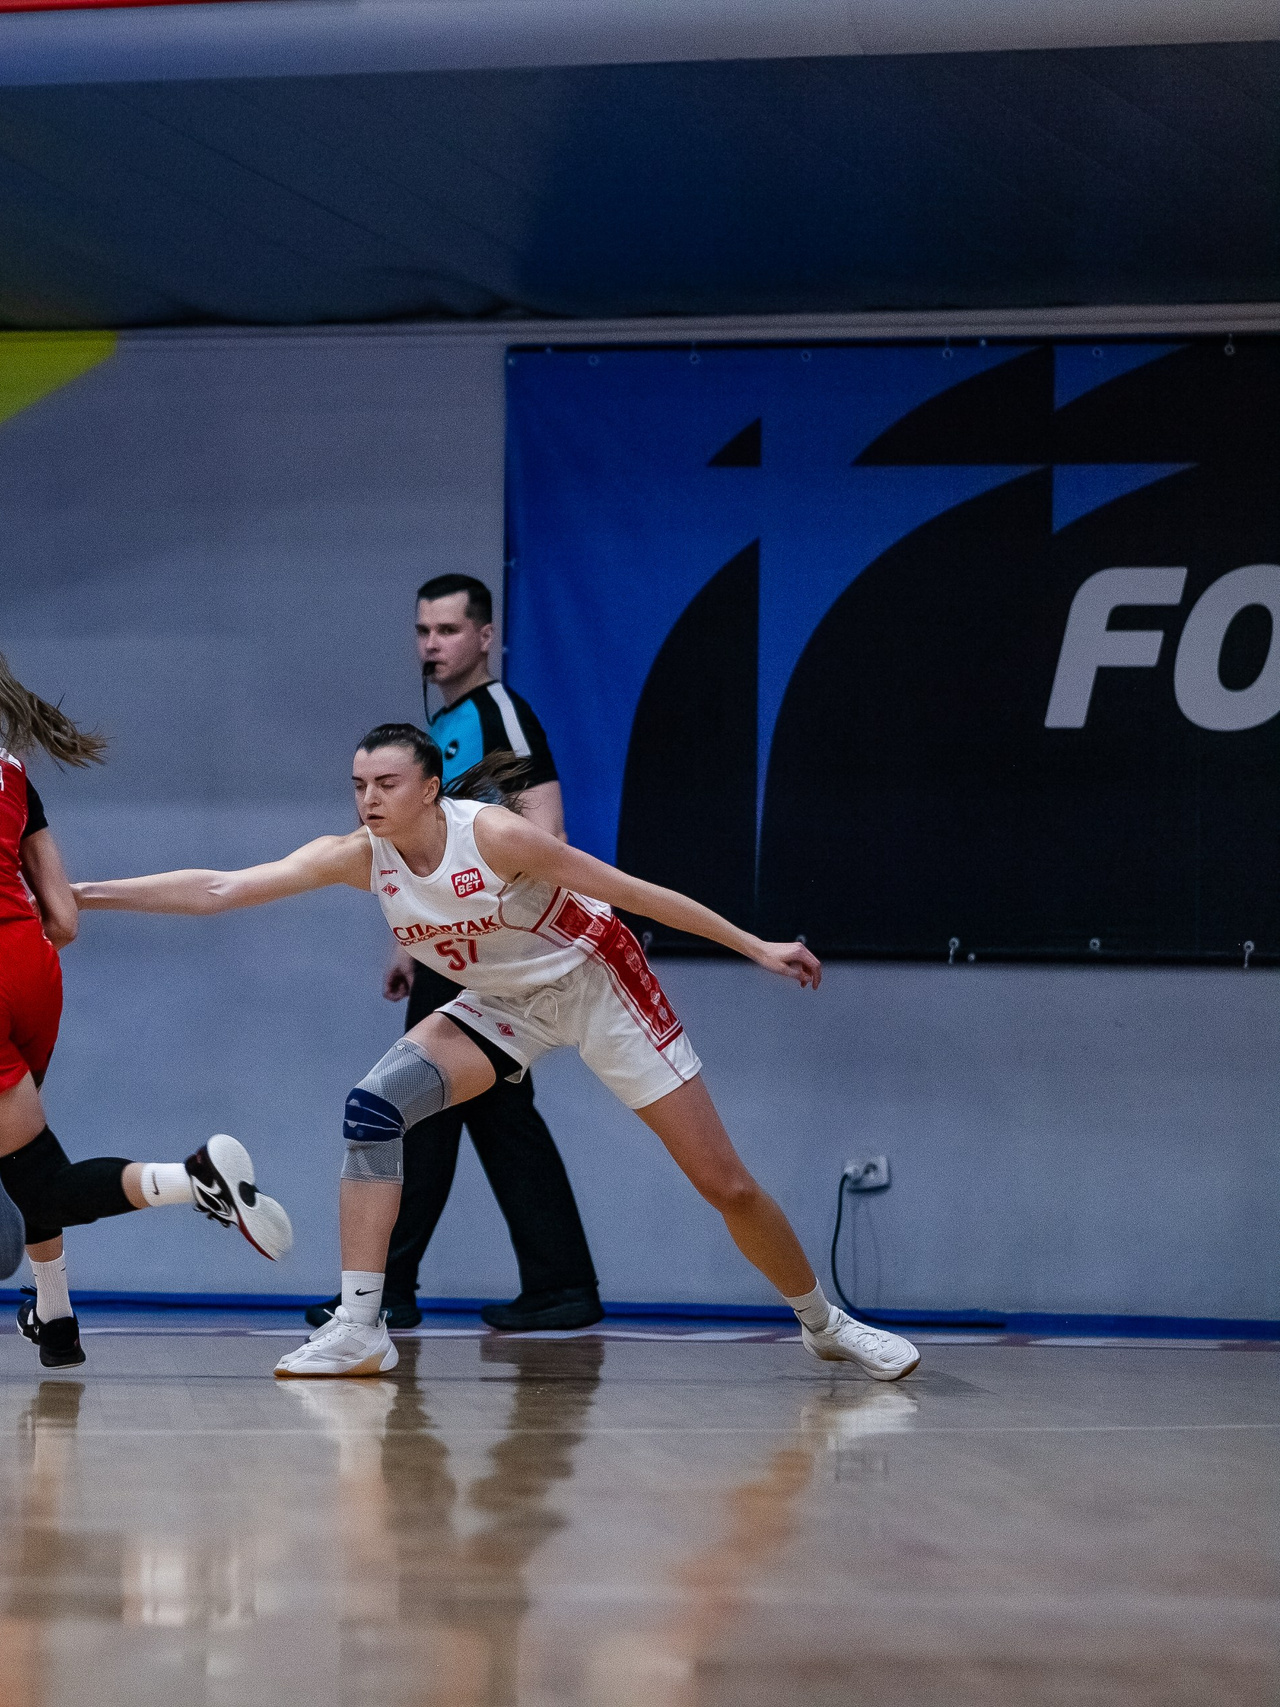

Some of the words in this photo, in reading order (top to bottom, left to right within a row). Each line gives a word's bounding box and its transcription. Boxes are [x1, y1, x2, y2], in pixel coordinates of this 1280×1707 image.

[1044, 563, 1280, 732] FO
[454, 870, 479, 886] FON
[457, 879, 481, 896] BET
[392, 914, 499, 941] СПАРТАК
[434, 937, 480, 972] 57
